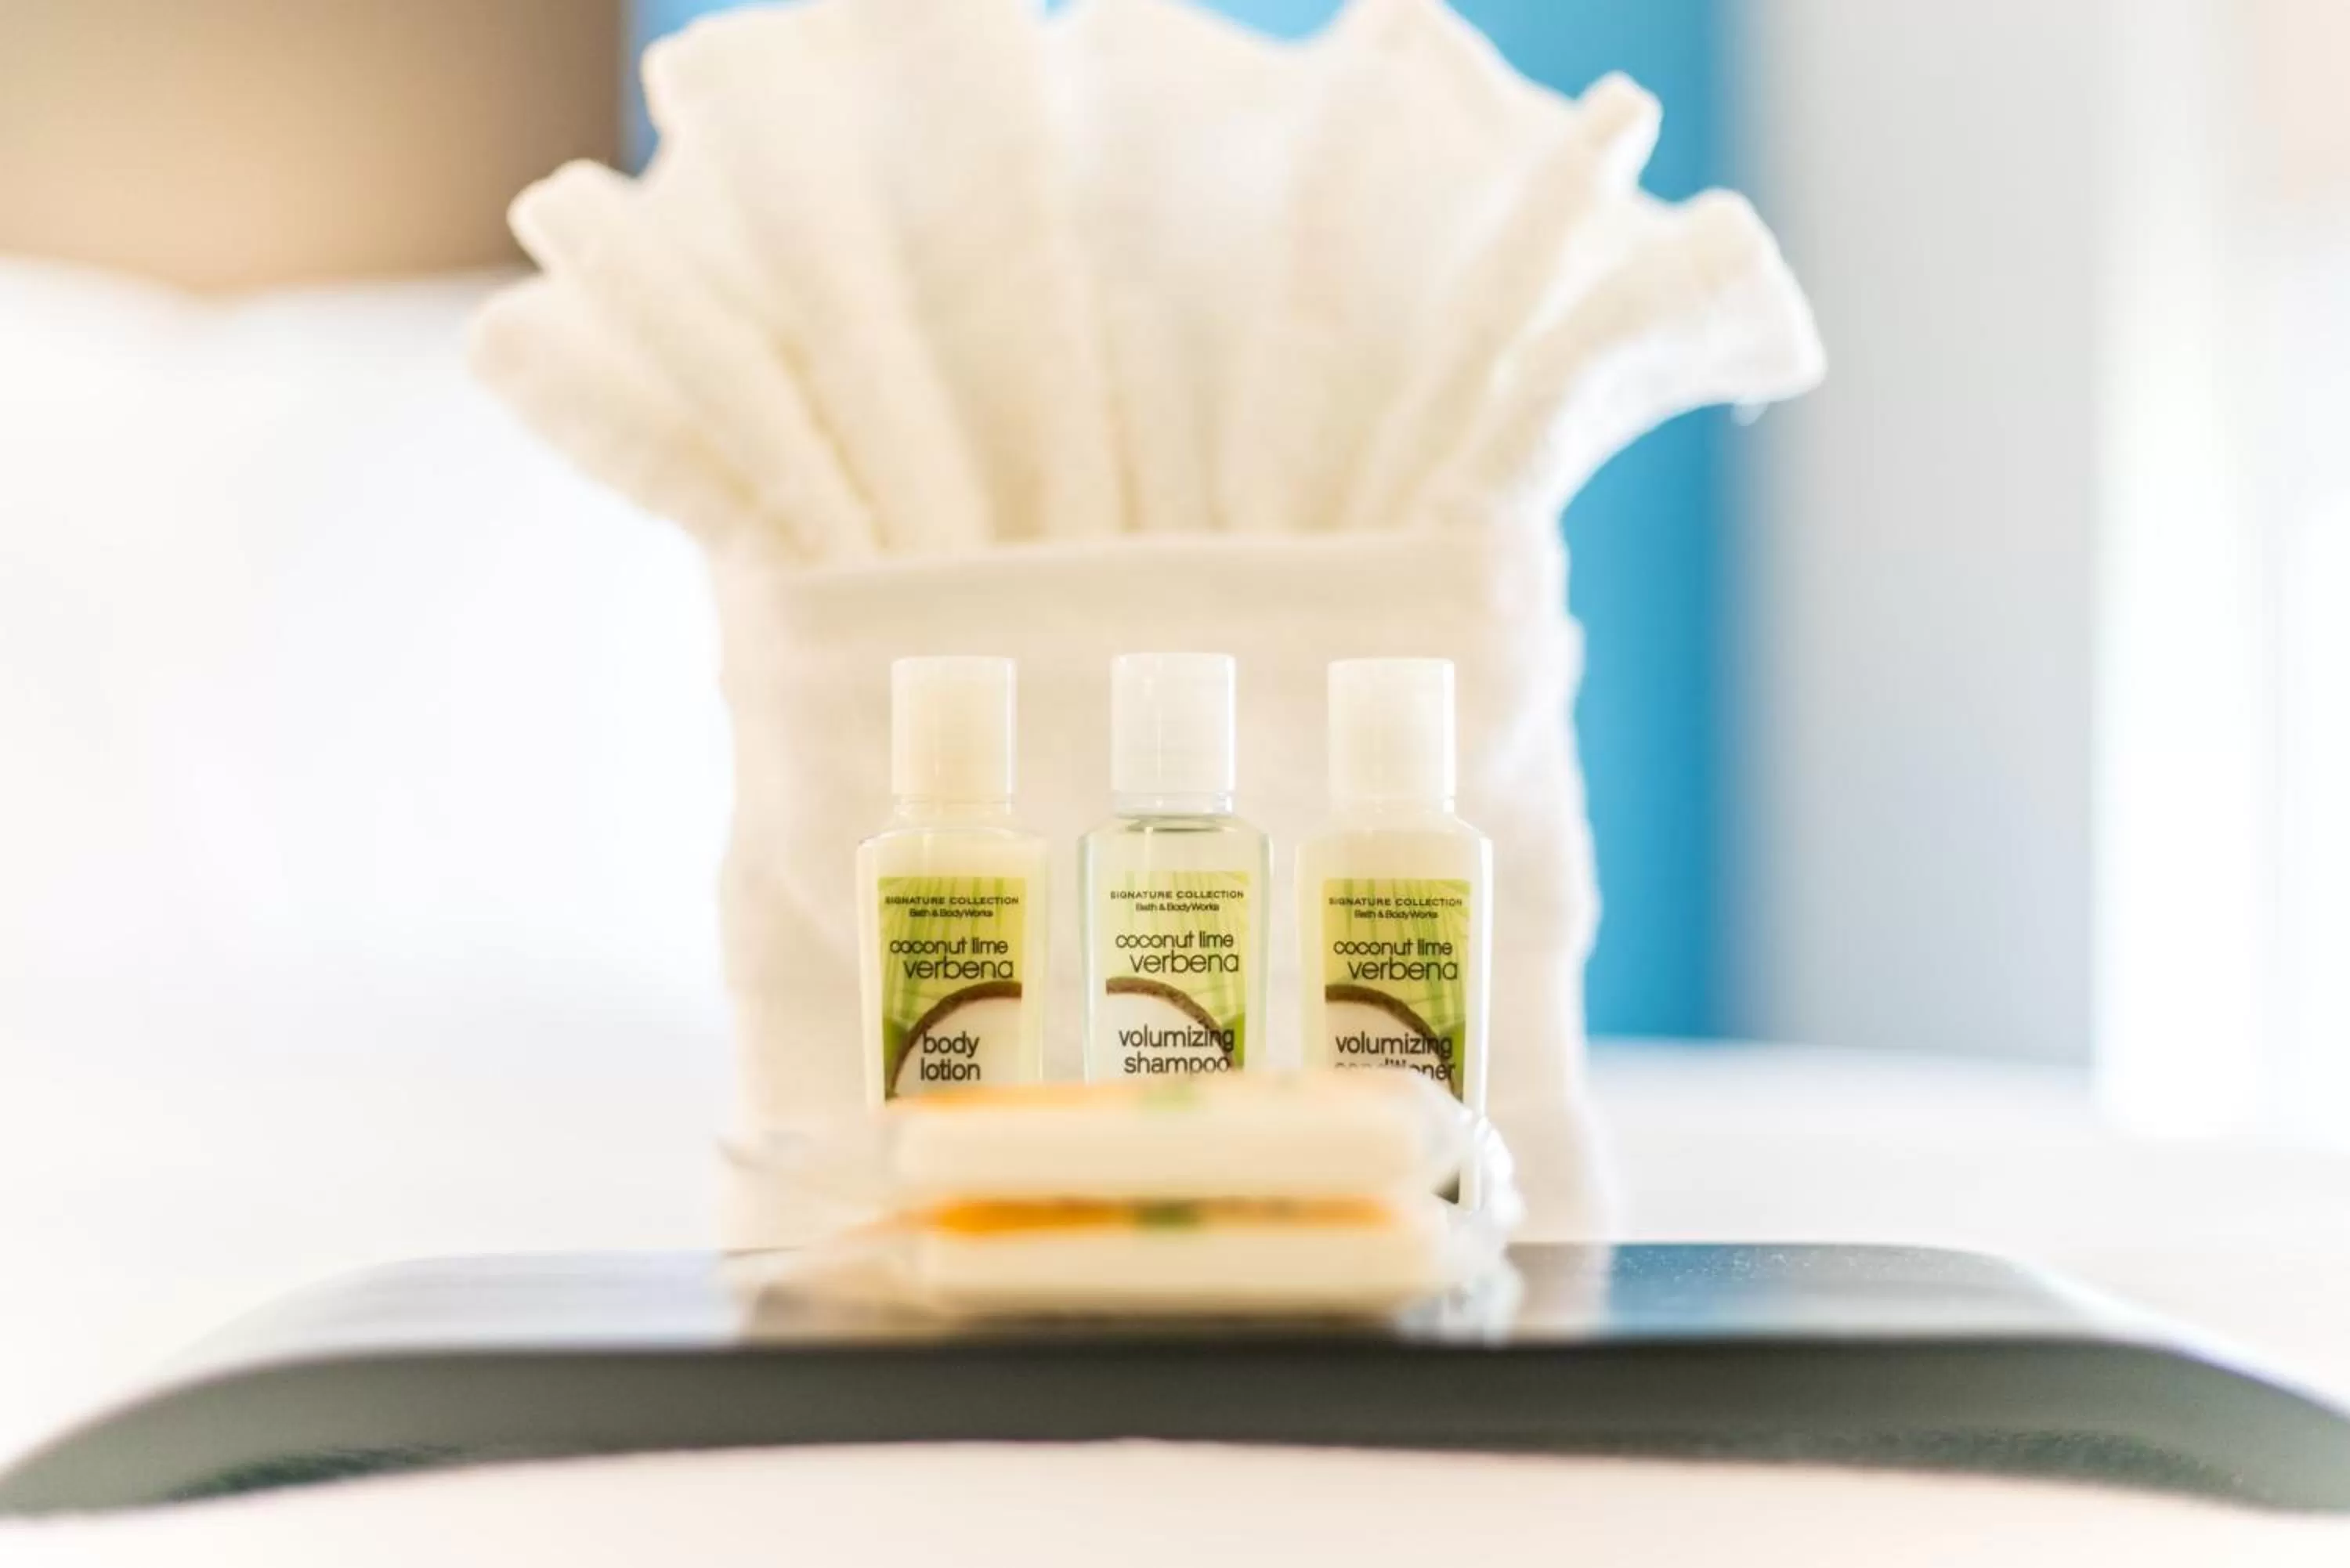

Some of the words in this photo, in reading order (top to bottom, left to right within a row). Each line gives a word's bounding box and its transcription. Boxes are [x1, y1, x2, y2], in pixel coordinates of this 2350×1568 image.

[885, 896, 945, 905] SIGNATURE
[949, 896, 1019, 905] COLLECTION
[1109, 891, 1173, 900] SIGNATURE
[1176, 891, 1244, 900] COLLECTION
[1329, 898, 1391, 906] SIGNATURE
[1394, 898, 1462, 906] COLLECTION
[909, 909, 930, 917] Bath
[1136, 902, 1157, 912] Bath
[1354, 909, 1376, 918] Bath
[890, 938, 967, 954] coconut
[971, 938, 1008, 954] lime
[1115, 931, 1195, 948] coconut
[1198, 930, 1234, 948] lime
[1333, 938, 1412, 956] coconut
[1417, 939, 1453, 956] lime
[904, 956, 1014, 979] verbena
[1130, 950, 1239, 974] verbena
[1347, 957, 1458, 980] verbena
[922, 1031, 980, 1057] body
[1119, 1023, 1235, 1053] volumizing
[1335, 1031, 1454, 1060] volumizing
[920, 1059, 981, 1081] lotion
[1124, 1051, 1231, 1075] shampoo
